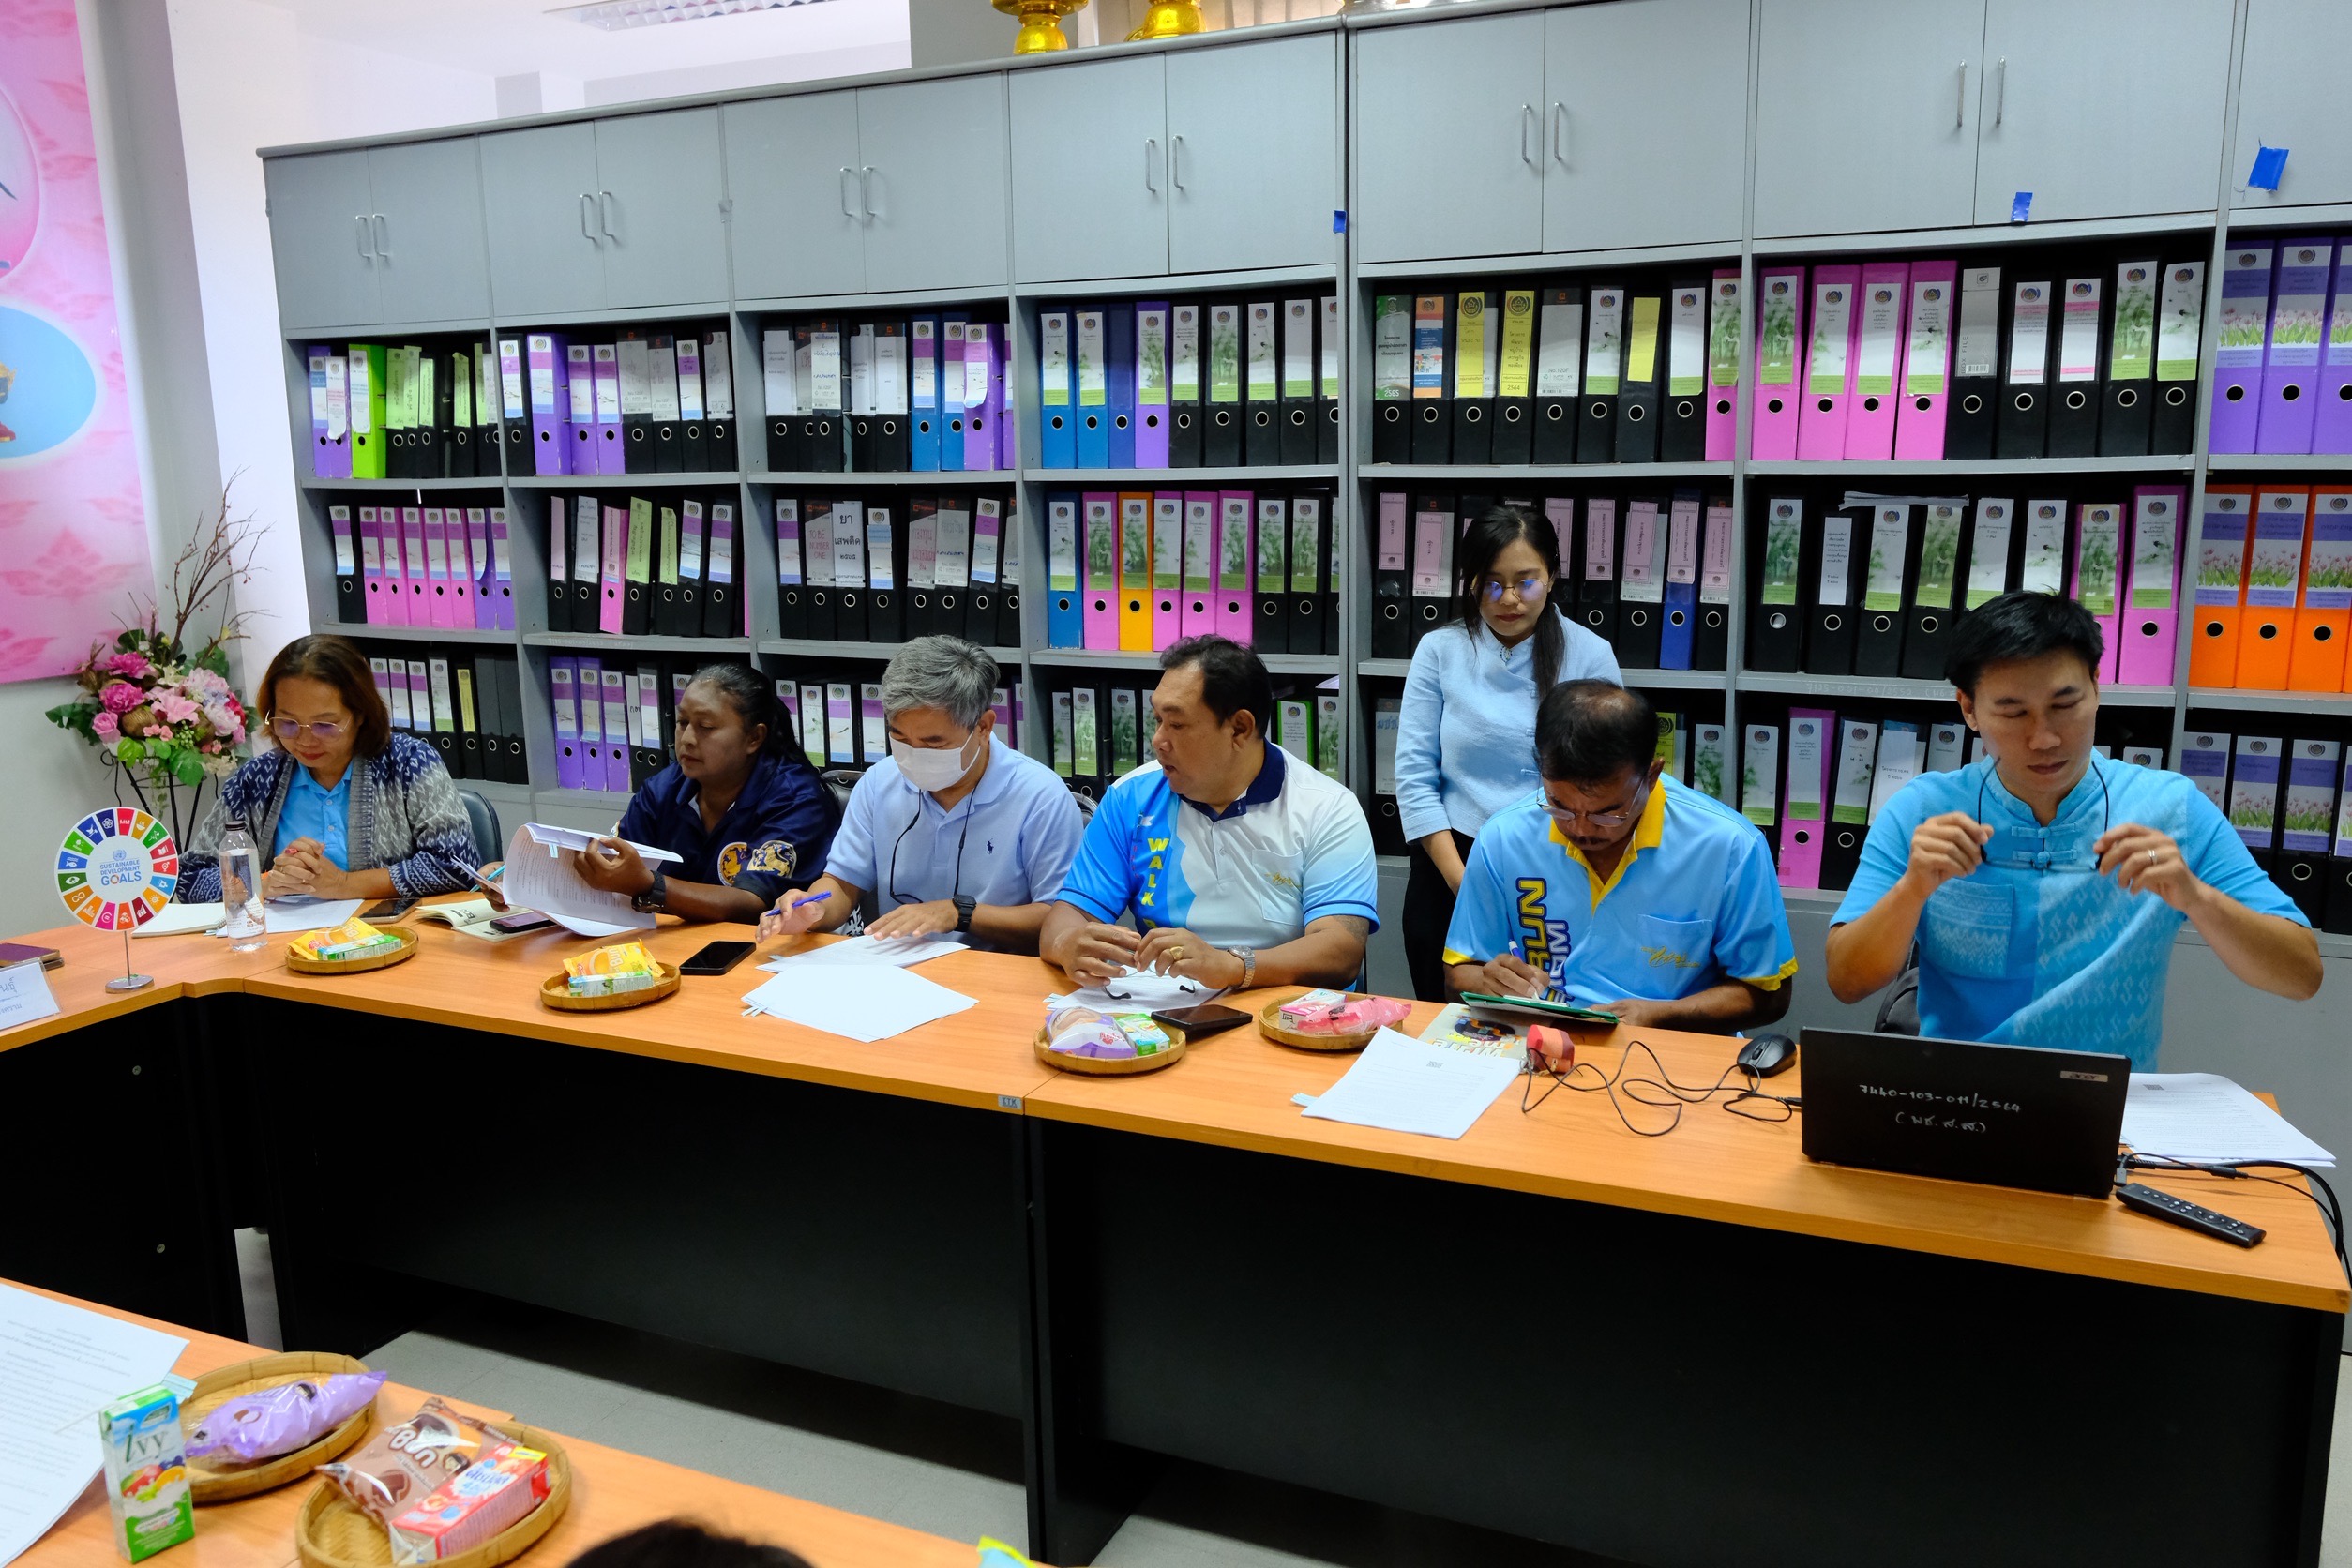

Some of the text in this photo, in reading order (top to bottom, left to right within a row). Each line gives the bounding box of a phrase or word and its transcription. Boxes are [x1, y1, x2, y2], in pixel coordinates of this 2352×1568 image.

[809, 530, 825, 539] TO BE
[809, 541, 830, 550] NUMBER
[813, 551, 826, 560] ONE
[99, 859, 141, 869] SUSTAINABLE
[100, 866, 141, 875] DEVELOPMENT
[1140, 837, 1170, 907] WALK
[100, 871, 142, 886] GOALS
[1518, 879, 1547, 970] RUN
